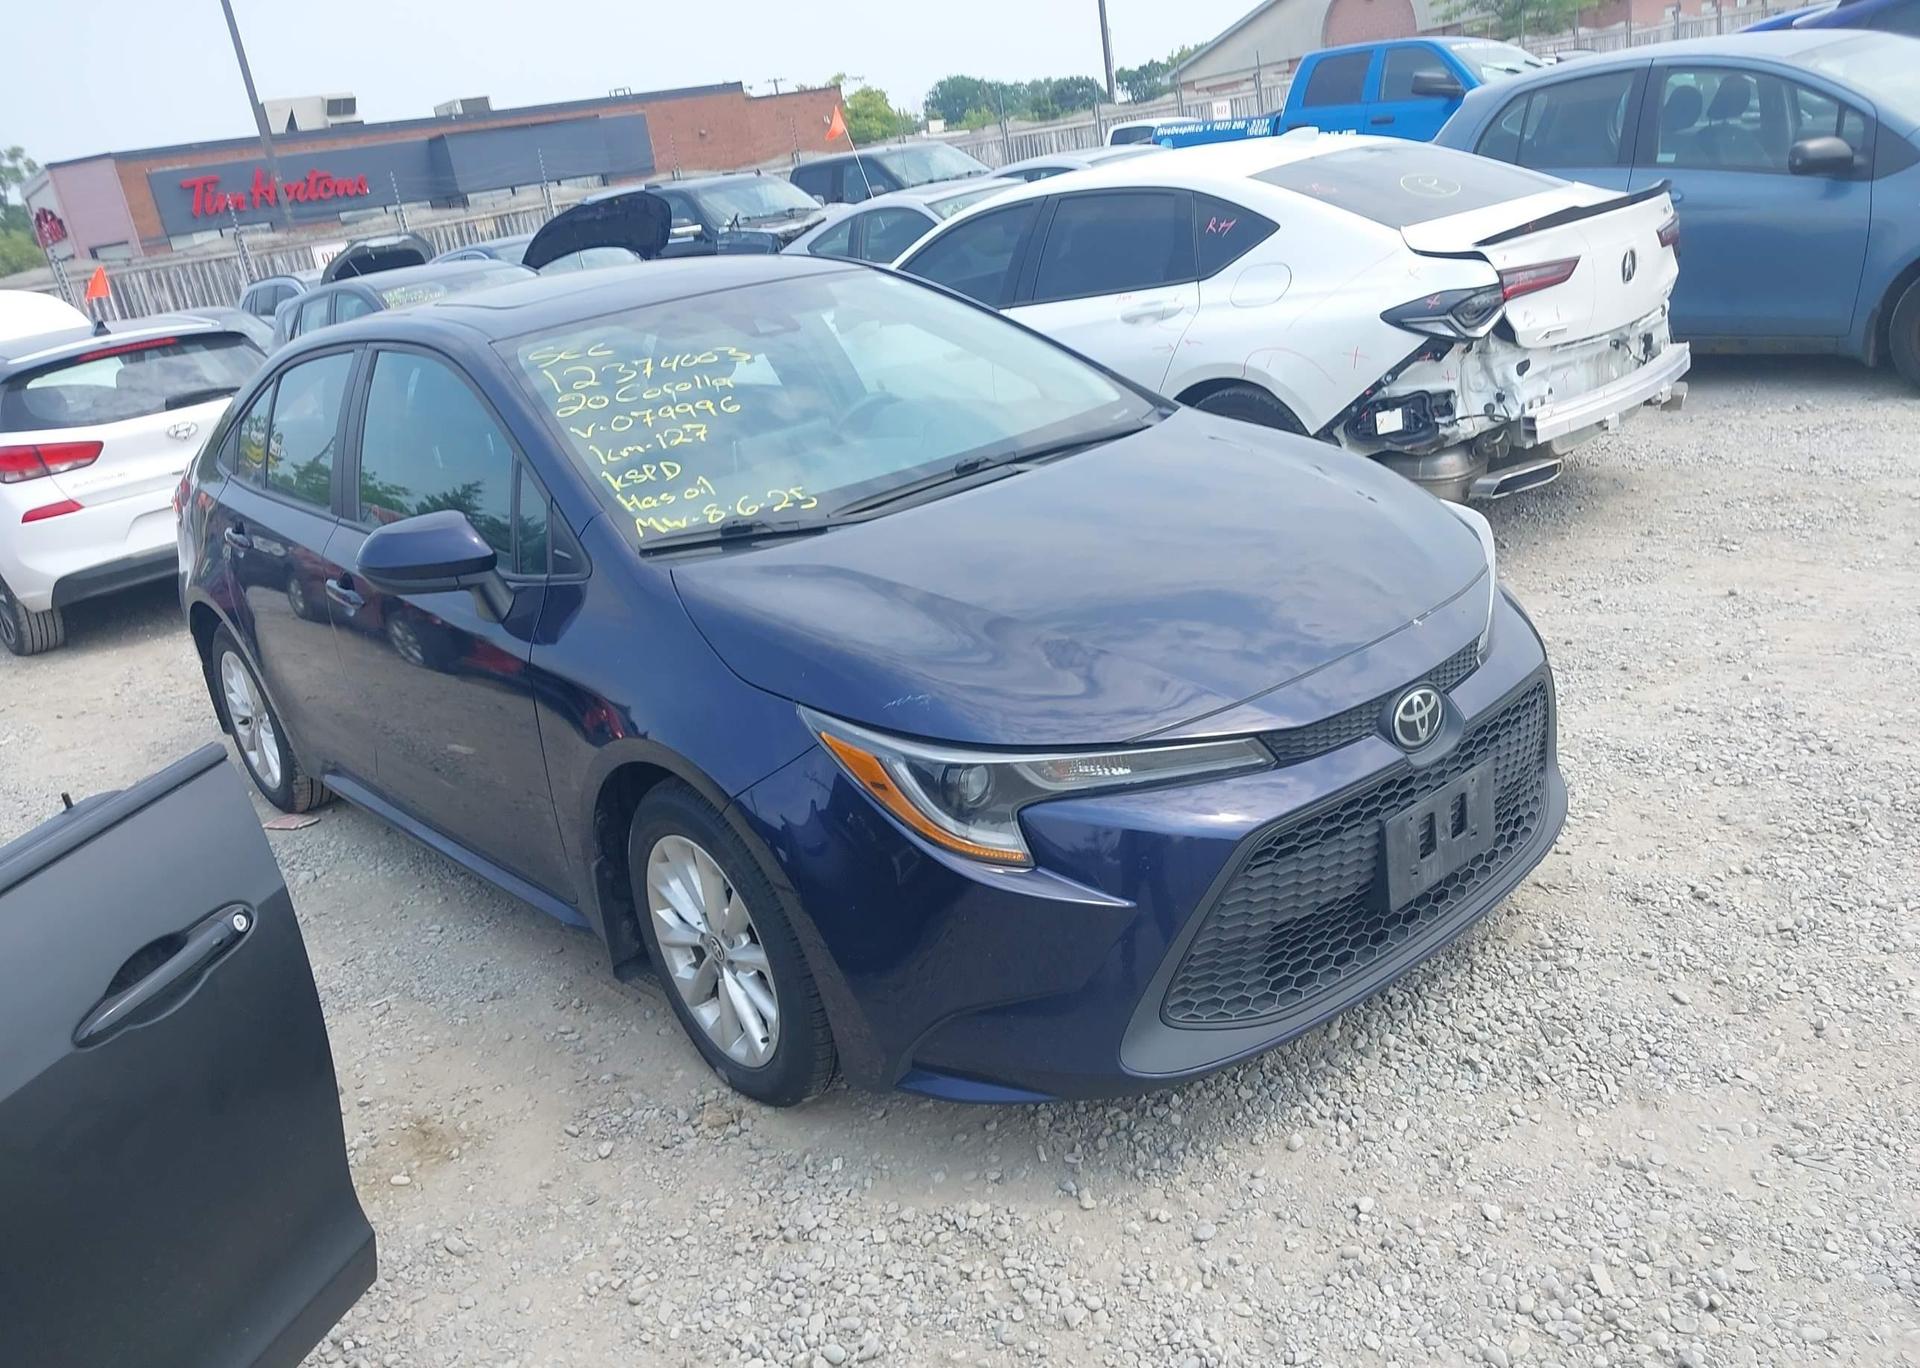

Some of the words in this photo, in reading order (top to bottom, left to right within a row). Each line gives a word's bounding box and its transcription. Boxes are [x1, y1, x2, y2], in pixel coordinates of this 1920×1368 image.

[181, 175, 247, 218] Tim
[251, 166, 368, 208] Hrtons
[556, 392, 609, 417] 20
